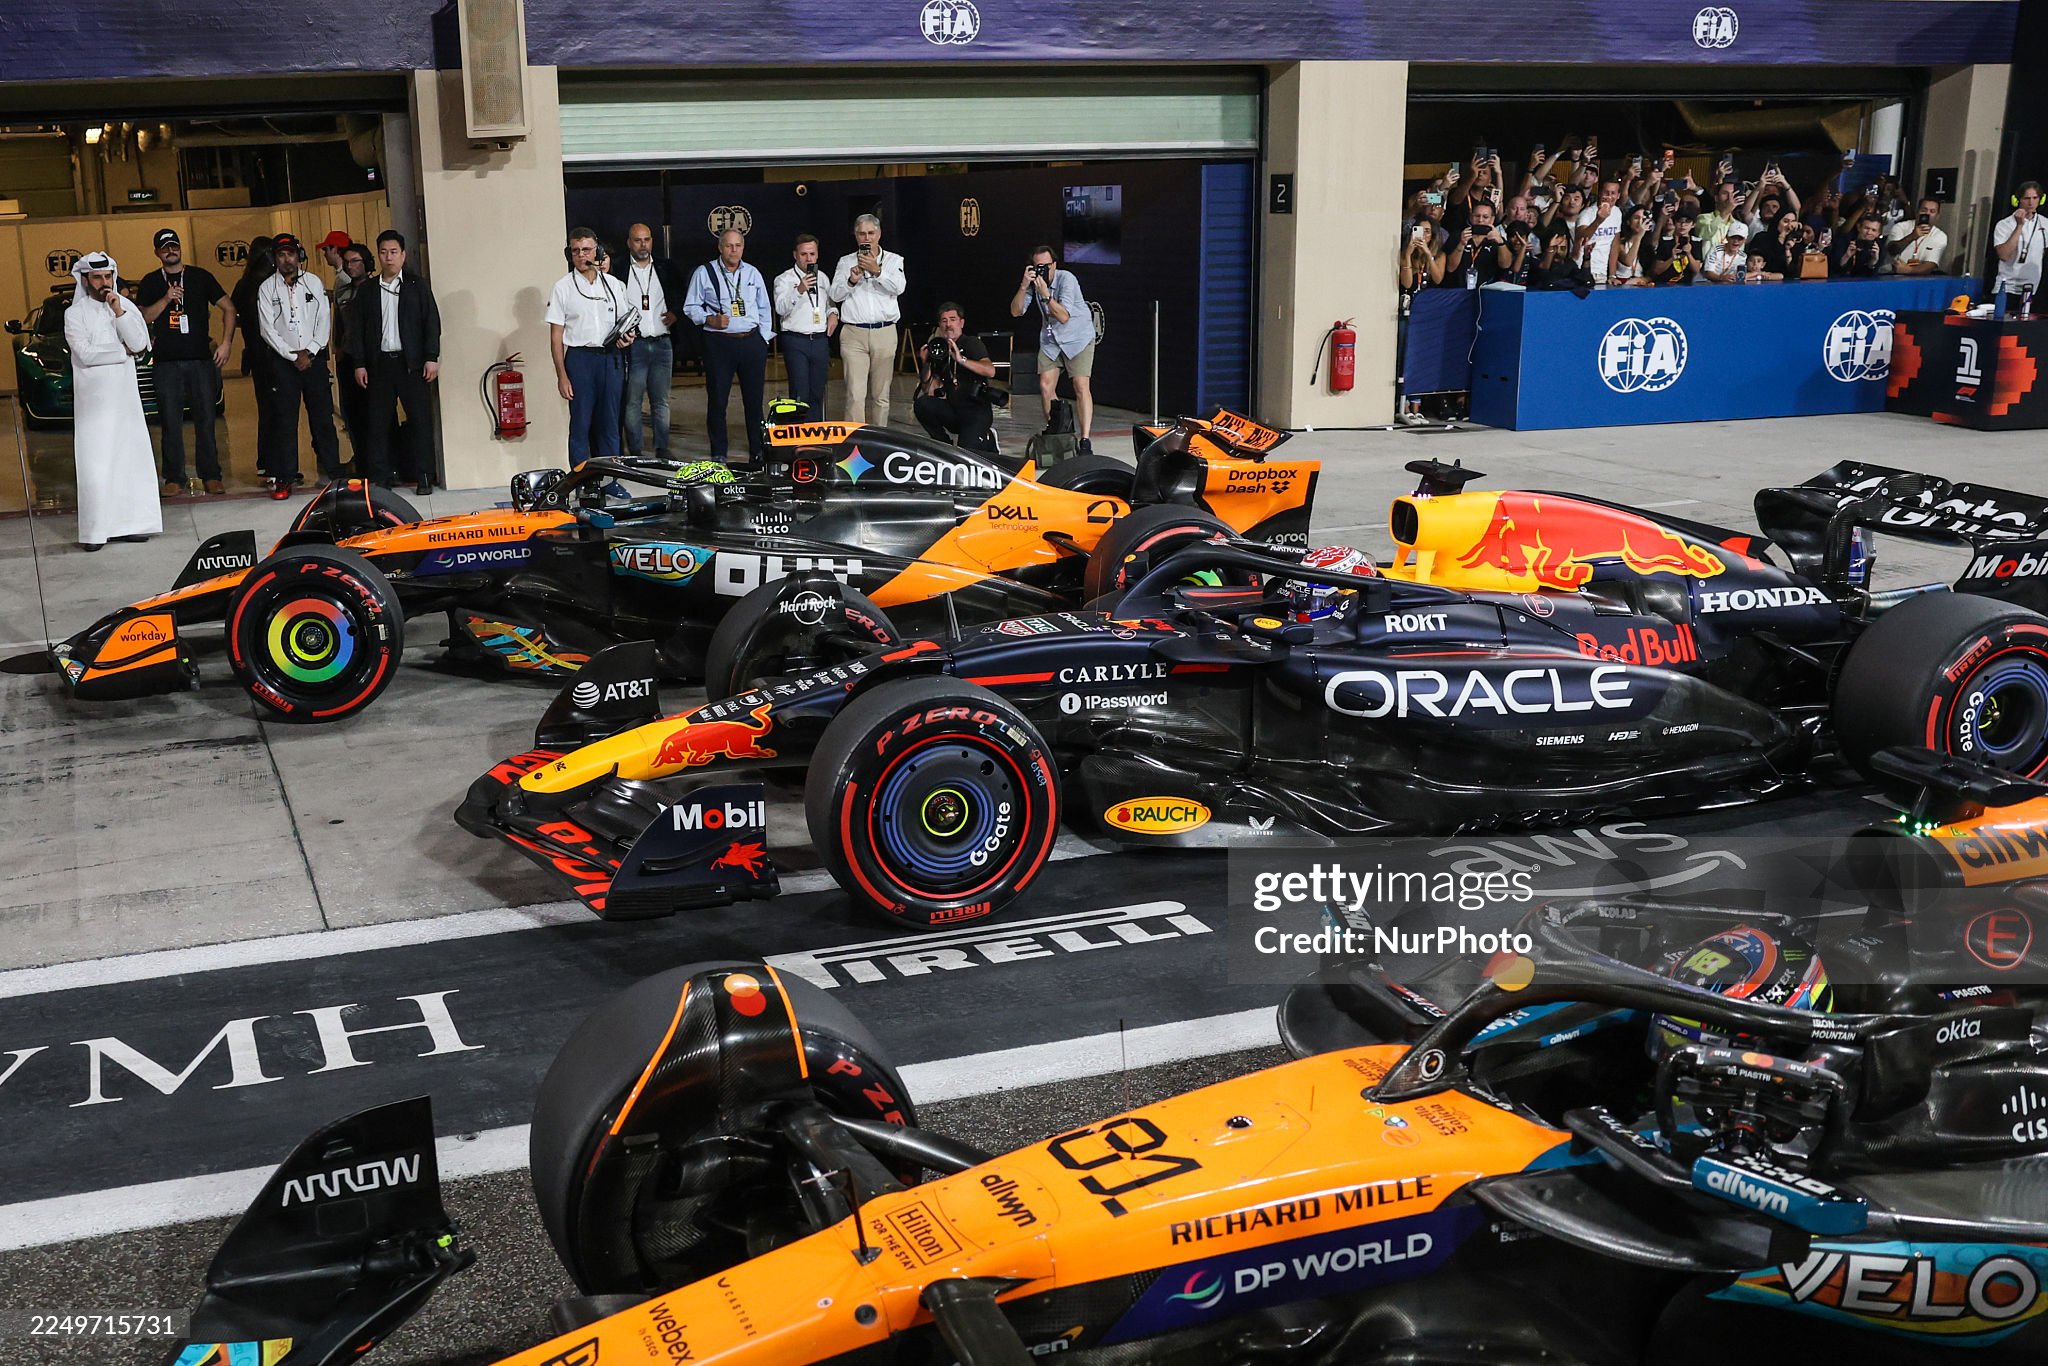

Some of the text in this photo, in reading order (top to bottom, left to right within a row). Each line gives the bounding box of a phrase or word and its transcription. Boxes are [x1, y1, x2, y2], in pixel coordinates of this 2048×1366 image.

[1277, 183, 1287, 203] 2
[1935, 177, 1946, 195] 1
[773, 425, 847, 441] allwyn
[883, 451, 1003, 490] Gemini
[1228, 467, 1298, 483] Dropbox
[723, 485, 746, 494] okta
[1225, 481, 1267, 494] Dash
[988, 505, 1039, 520] DELL
[429, 525, 526, 543] RICHARD MILLE
[990, 522, 1040, 534] Technologies
[1275, 532, 1308, 545] groq
[197, 554, 252, 571] ARROW
[457, 548, 532, 565] DP WORLD
[615, 546, 696, 574] VELO
[300, 563, 319, 574] P
[322, 566, 383, 613] ZERO
[779, 595, 837, 614] Hard Rock
[1700, 586, 1832, 614] HONDA
[844, 607, 892, 644] ERO
[1028, 617, 1054, 633] TAG
[1384, 613, 1448, 633] ROKT
[120, 630, 167, 642] workday
[1577, 623, 1698, 666] Red Bull
[1944, 634, 1994, 684] PIRELLI
[1059, 662, 1168, 684] CARLYLE
[251, 680, 294, 713] PIRELLI
[604, 678, 654, 702] AT&T
[1084, 691, 1168, 710] 1Password
[1325, 666, 1634, 718] ORACLE
[876, 730, 894, 756] P
[902, 706, 999, 736] ZERO
[1668, 722, 1699, 735] HEXAGON
[1535, 734, 1585, 747] SIEMENS
[673, 800, 767, 832] Mobil
[1133, 806, 1198, 823] RAUCH
[1428, 822, 1690, 876] aws
[928, 901, 992, 925] PIRELLI
[763, 900, 1215, 990] PIRELLI
[1951, 984, 1993, 999] PIASTRI
[1812, 1019, 1835, 1029] IRON
[1936, 1017, 1981, 1044] okta
[1549, 1028, 1581, 1046] allwyn
[1811, 1030, 1857, 1041] MOUNTAIN
[826, 1058, 863, 1078] P
[282, 1153, 421, 1208] ARROW
[980, 1173, 1038, 1228] allwyn
[1706, 1170, 1790, 1214] allwyn
[1170, 1175, 1434, 1245] RICHARD MILLE
[897, 1208, 944, 1258] Hilton
[870, 1218, 918, 1271] FOR THE STAY
[1234, 1232, 1433, 1295] DP WORLD
[1781, 1249, 2039, 1320] VELO
[648, 1301, 695, 1366] webex
